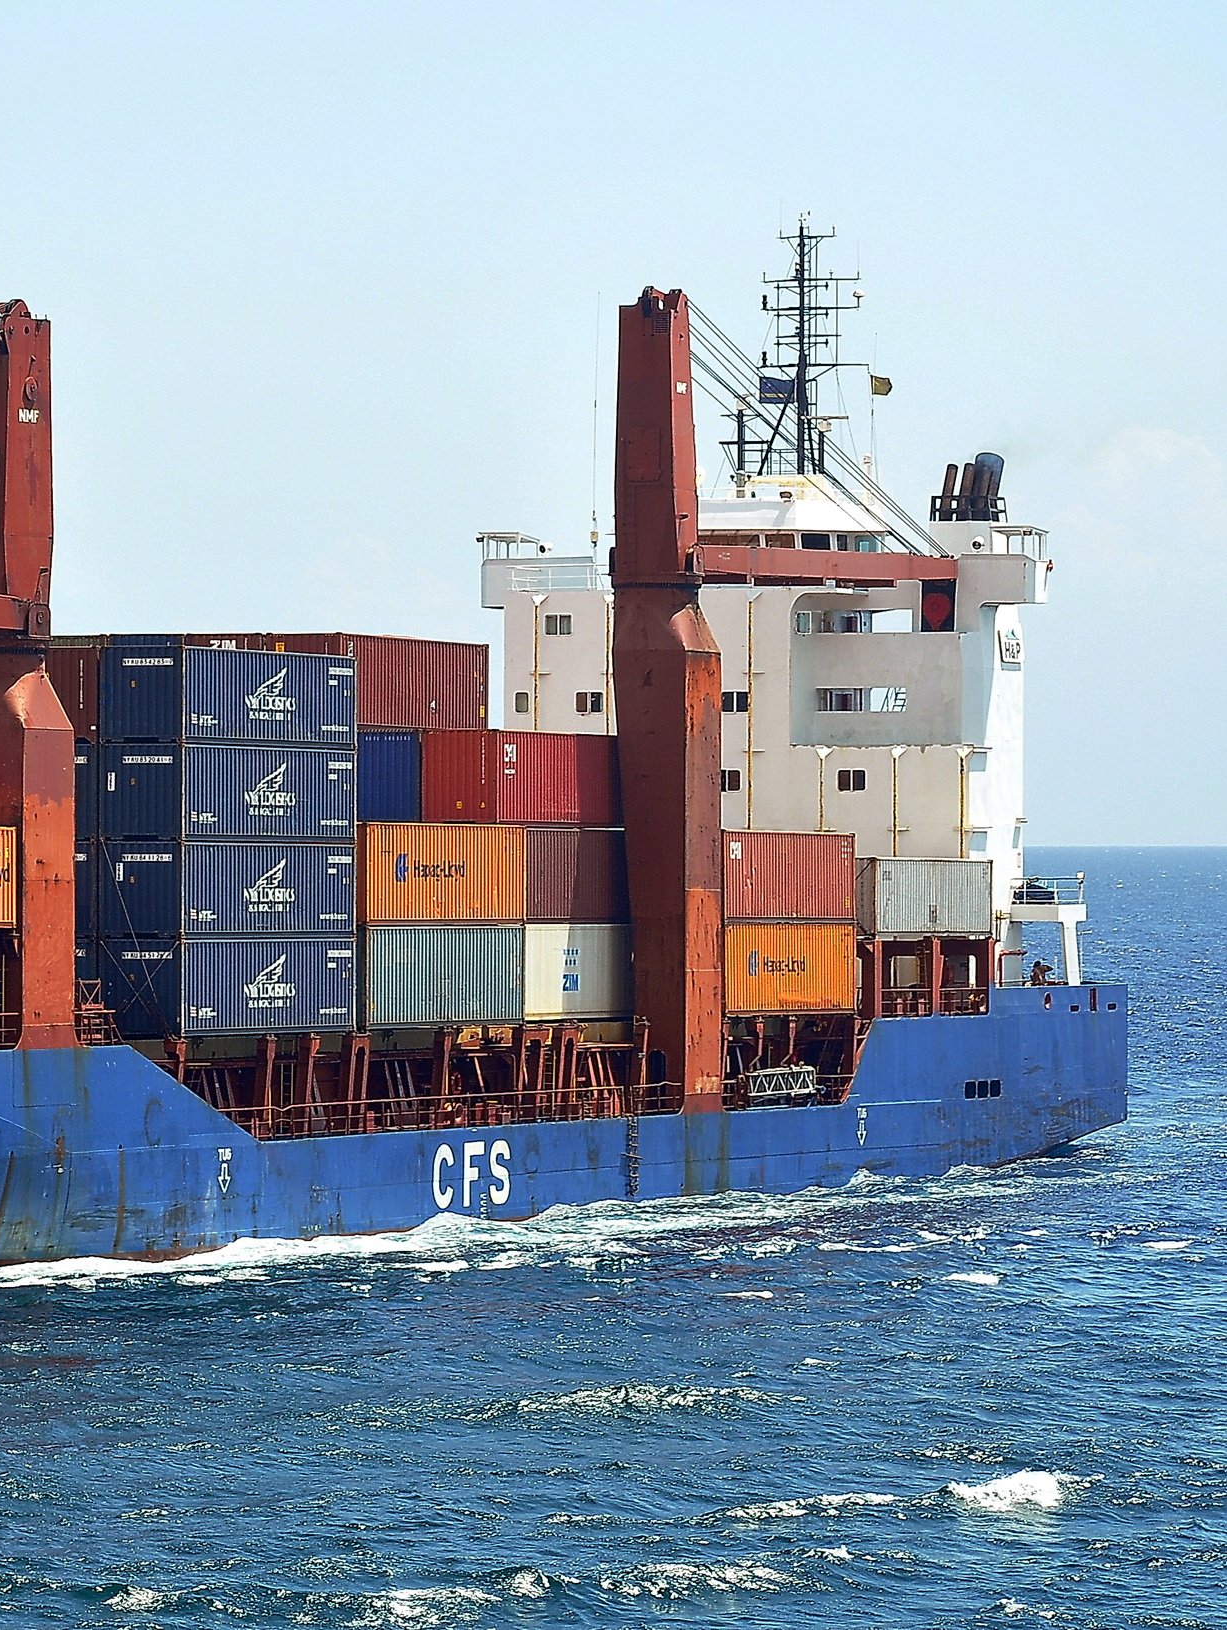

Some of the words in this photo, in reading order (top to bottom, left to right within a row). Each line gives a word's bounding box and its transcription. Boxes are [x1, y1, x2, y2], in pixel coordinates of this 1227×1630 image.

[18, 408, 39, 423] NMF
[1004, 641, 1021, 659] H&P
[413, 860, 466, 882] Hapag-Lloyd
[217, 1148, 232, 1161] TUG
[432, 1139, 511, 1209] CFS
